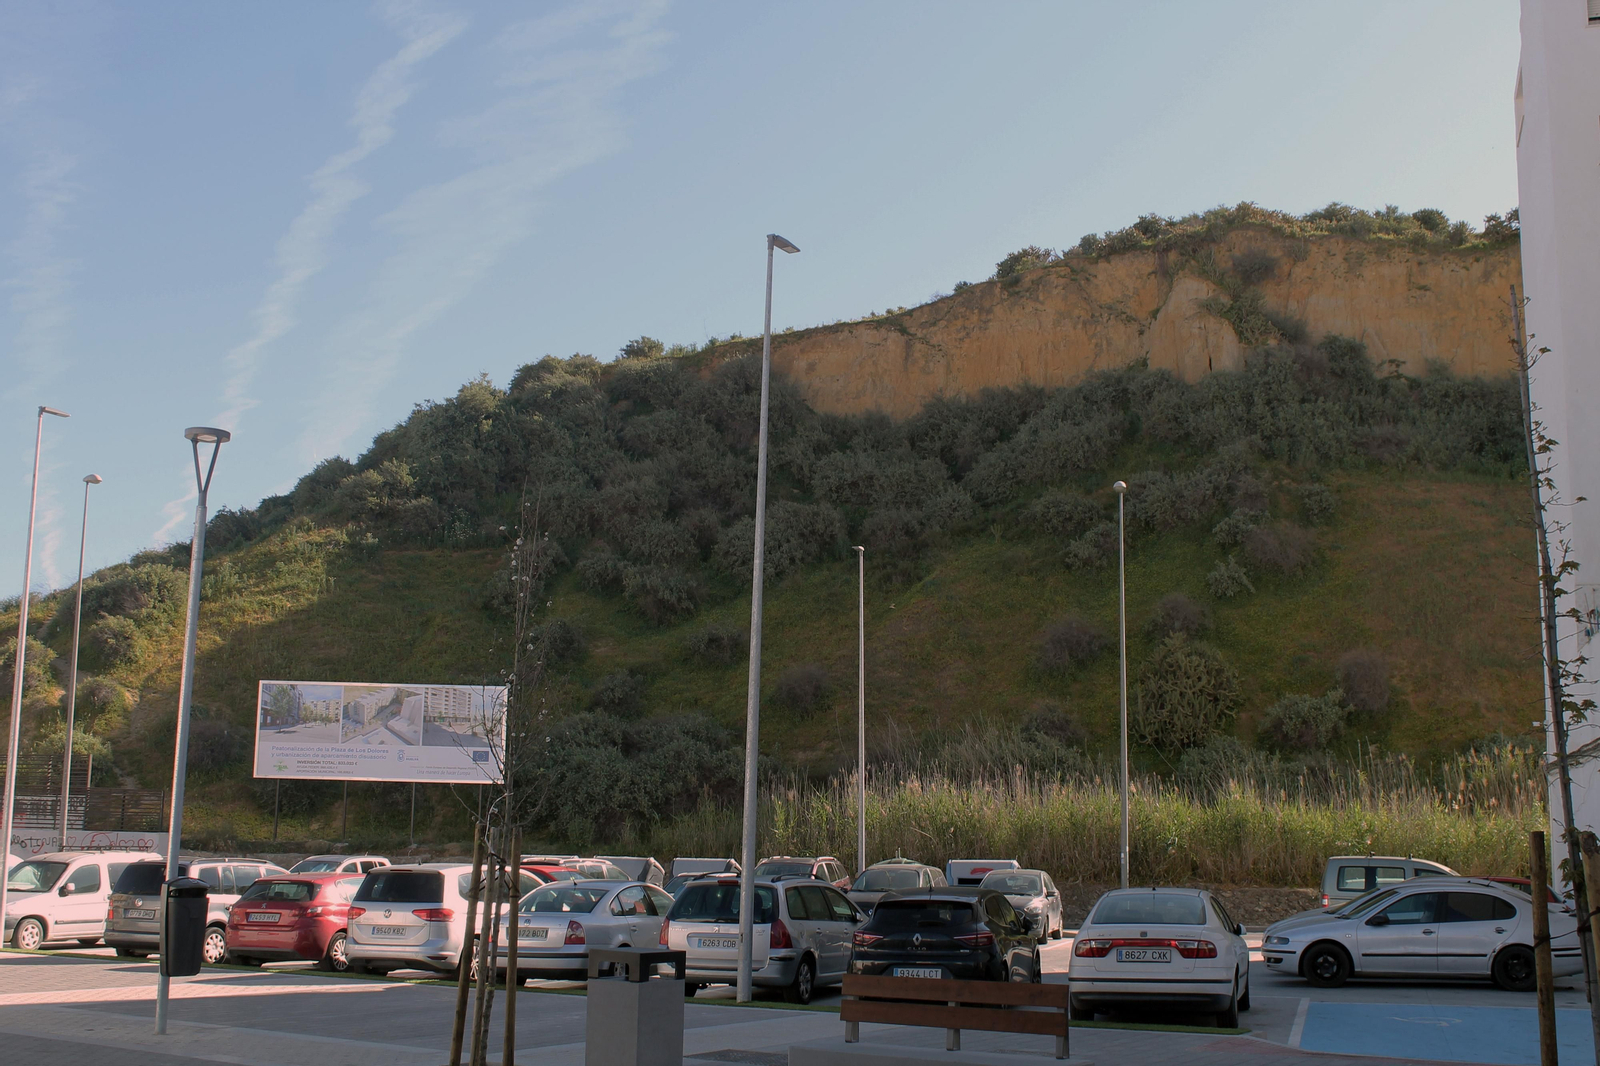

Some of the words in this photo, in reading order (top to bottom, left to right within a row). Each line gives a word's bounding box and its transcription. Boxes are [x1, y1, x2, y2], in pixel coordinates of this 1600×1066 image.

[702, 939, 720, 947] 6263
[722, 940, 737, 948] CDB
[1124, 950, 1146, 960] 8627
[1151, 951, 1168, 960] CXK
[899, 969, 920, 977] 9344
[923, 970, 940, 979] LCT
